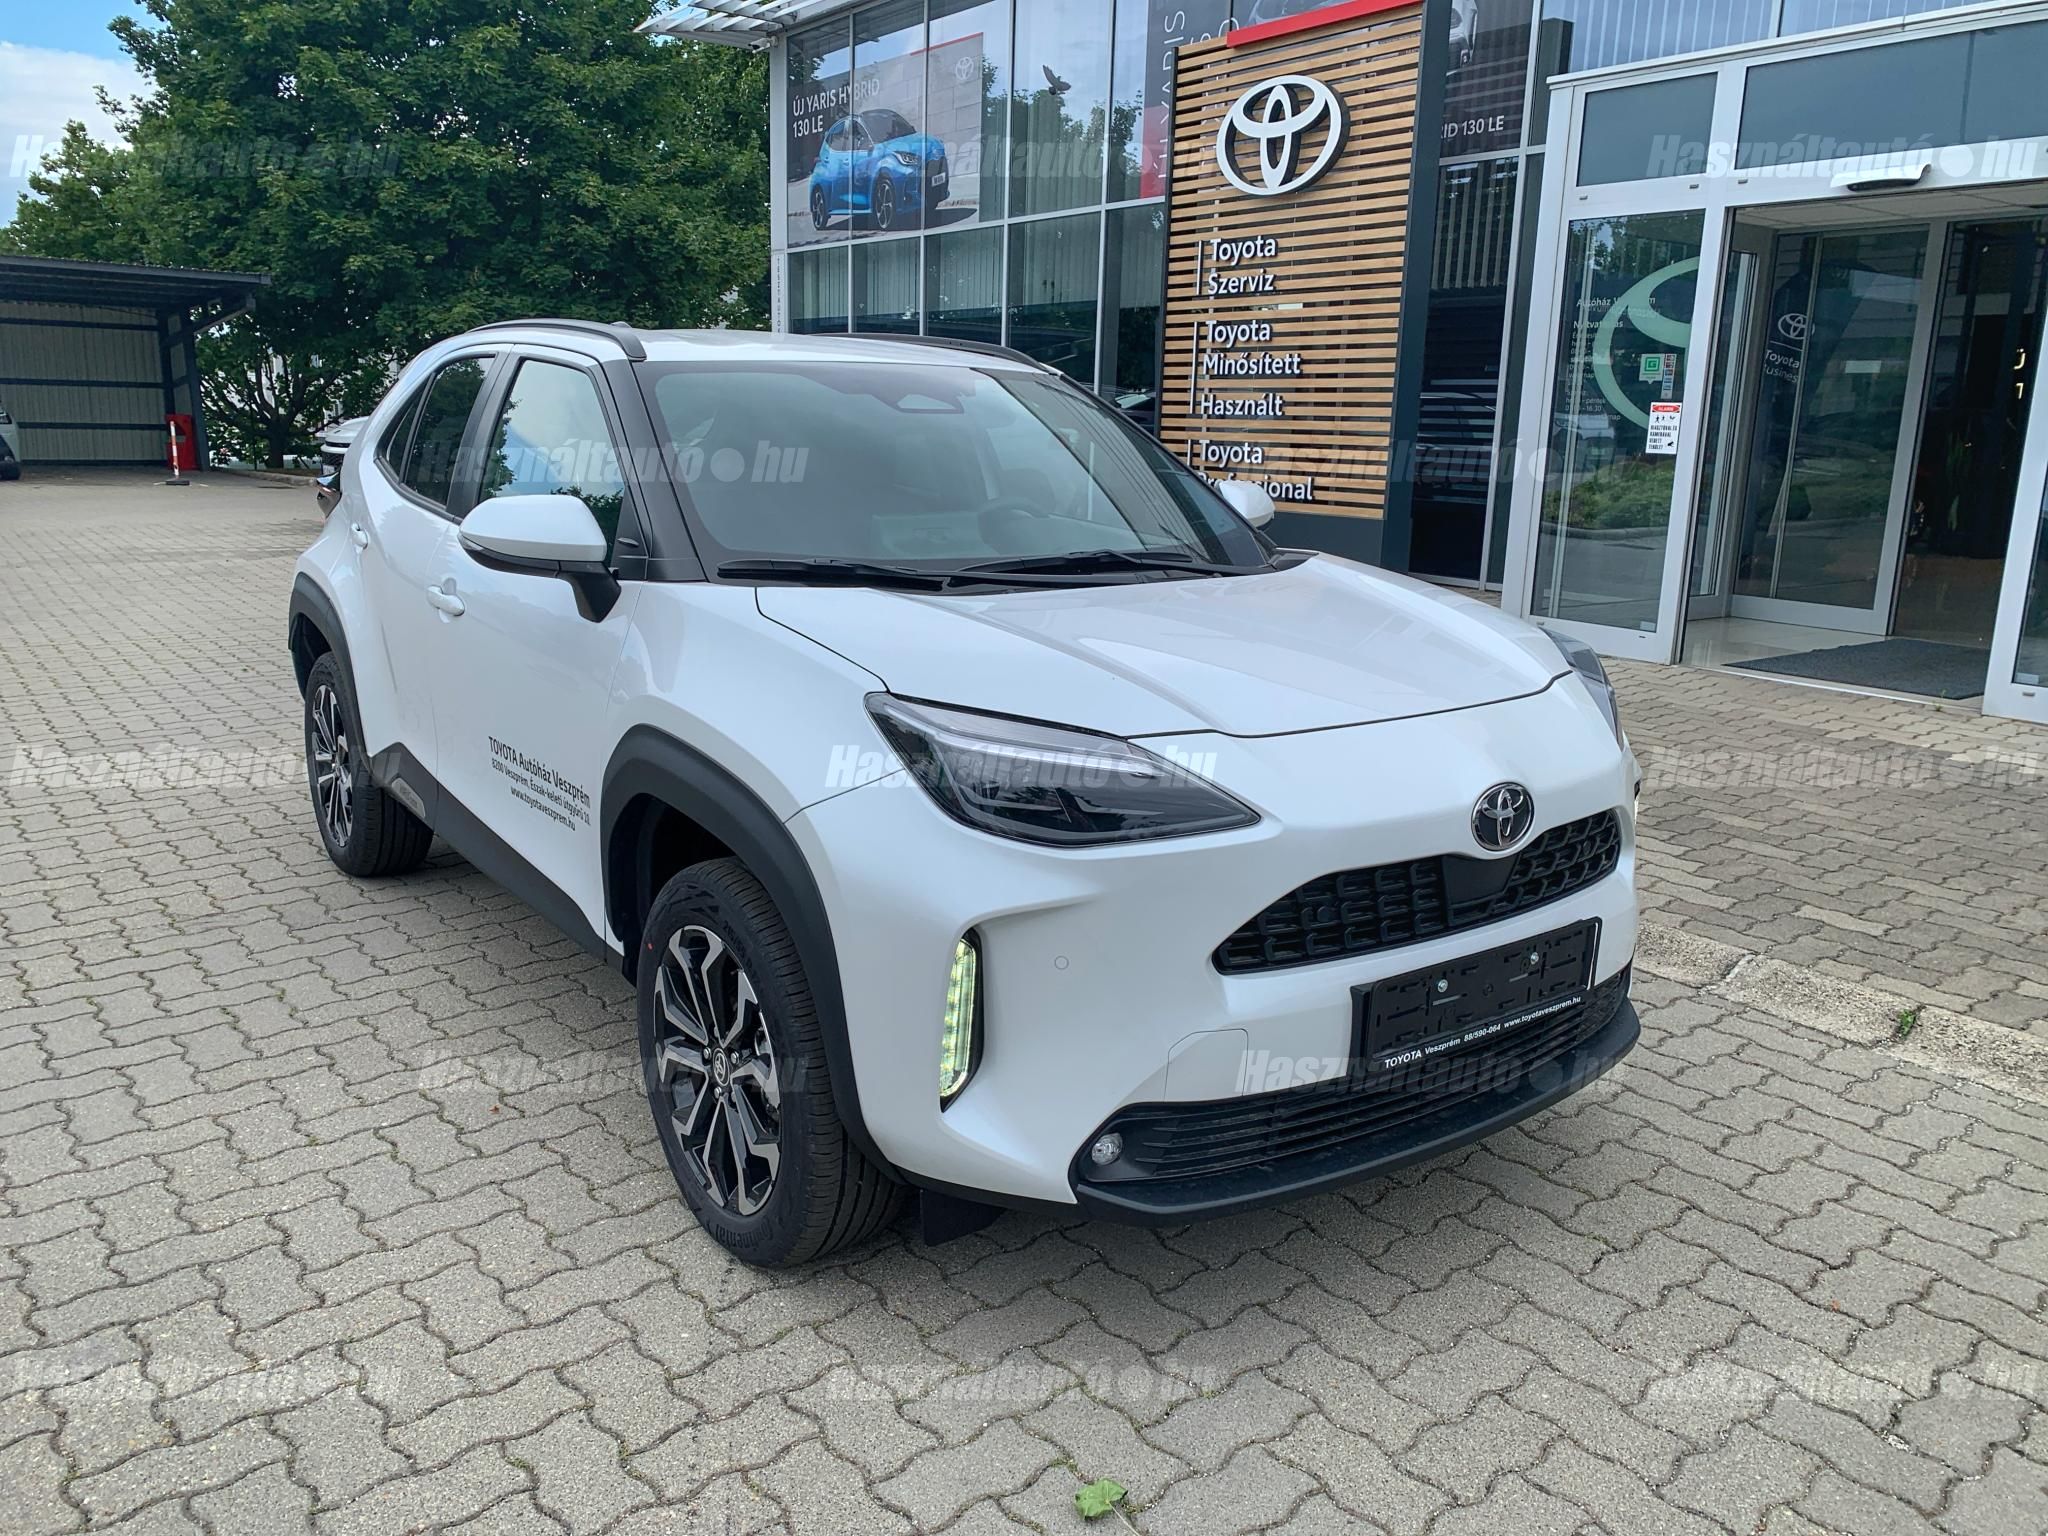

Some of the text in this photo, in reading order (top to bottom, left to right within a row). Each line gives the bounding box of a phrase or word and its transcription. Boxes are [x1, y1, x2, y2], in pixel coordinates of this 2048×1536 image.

[793, 78, 880, 118] ÚJ YARIS HYBRID
[793, 118, 824, 139] 130 LE
[1462, 118, 1485, 136] 130
[1488, 115, 1505, 133] LE
[1210, 235, 1277, 265] Toyota
[1207, 268, 1275, 295] Szerviz
[1206, 319, 1271, 347] Toyota
[1202, 351, 1301, 375] Minősített
[1765, 349, 1800, 369] Toyota
[1200, 392, 1283, 416] Használt
[1199, 439, 1264, 467] Toyota
[488, 736, 591, 809] TOYOTA Autóház Veszprém
[1384, 1049, 1422, 1069] TOYOTA
[1424, 1037, 1461, 1055] Veszprém
[1504, 996, 1581, 1028] www.toyotaveszprem.hu
